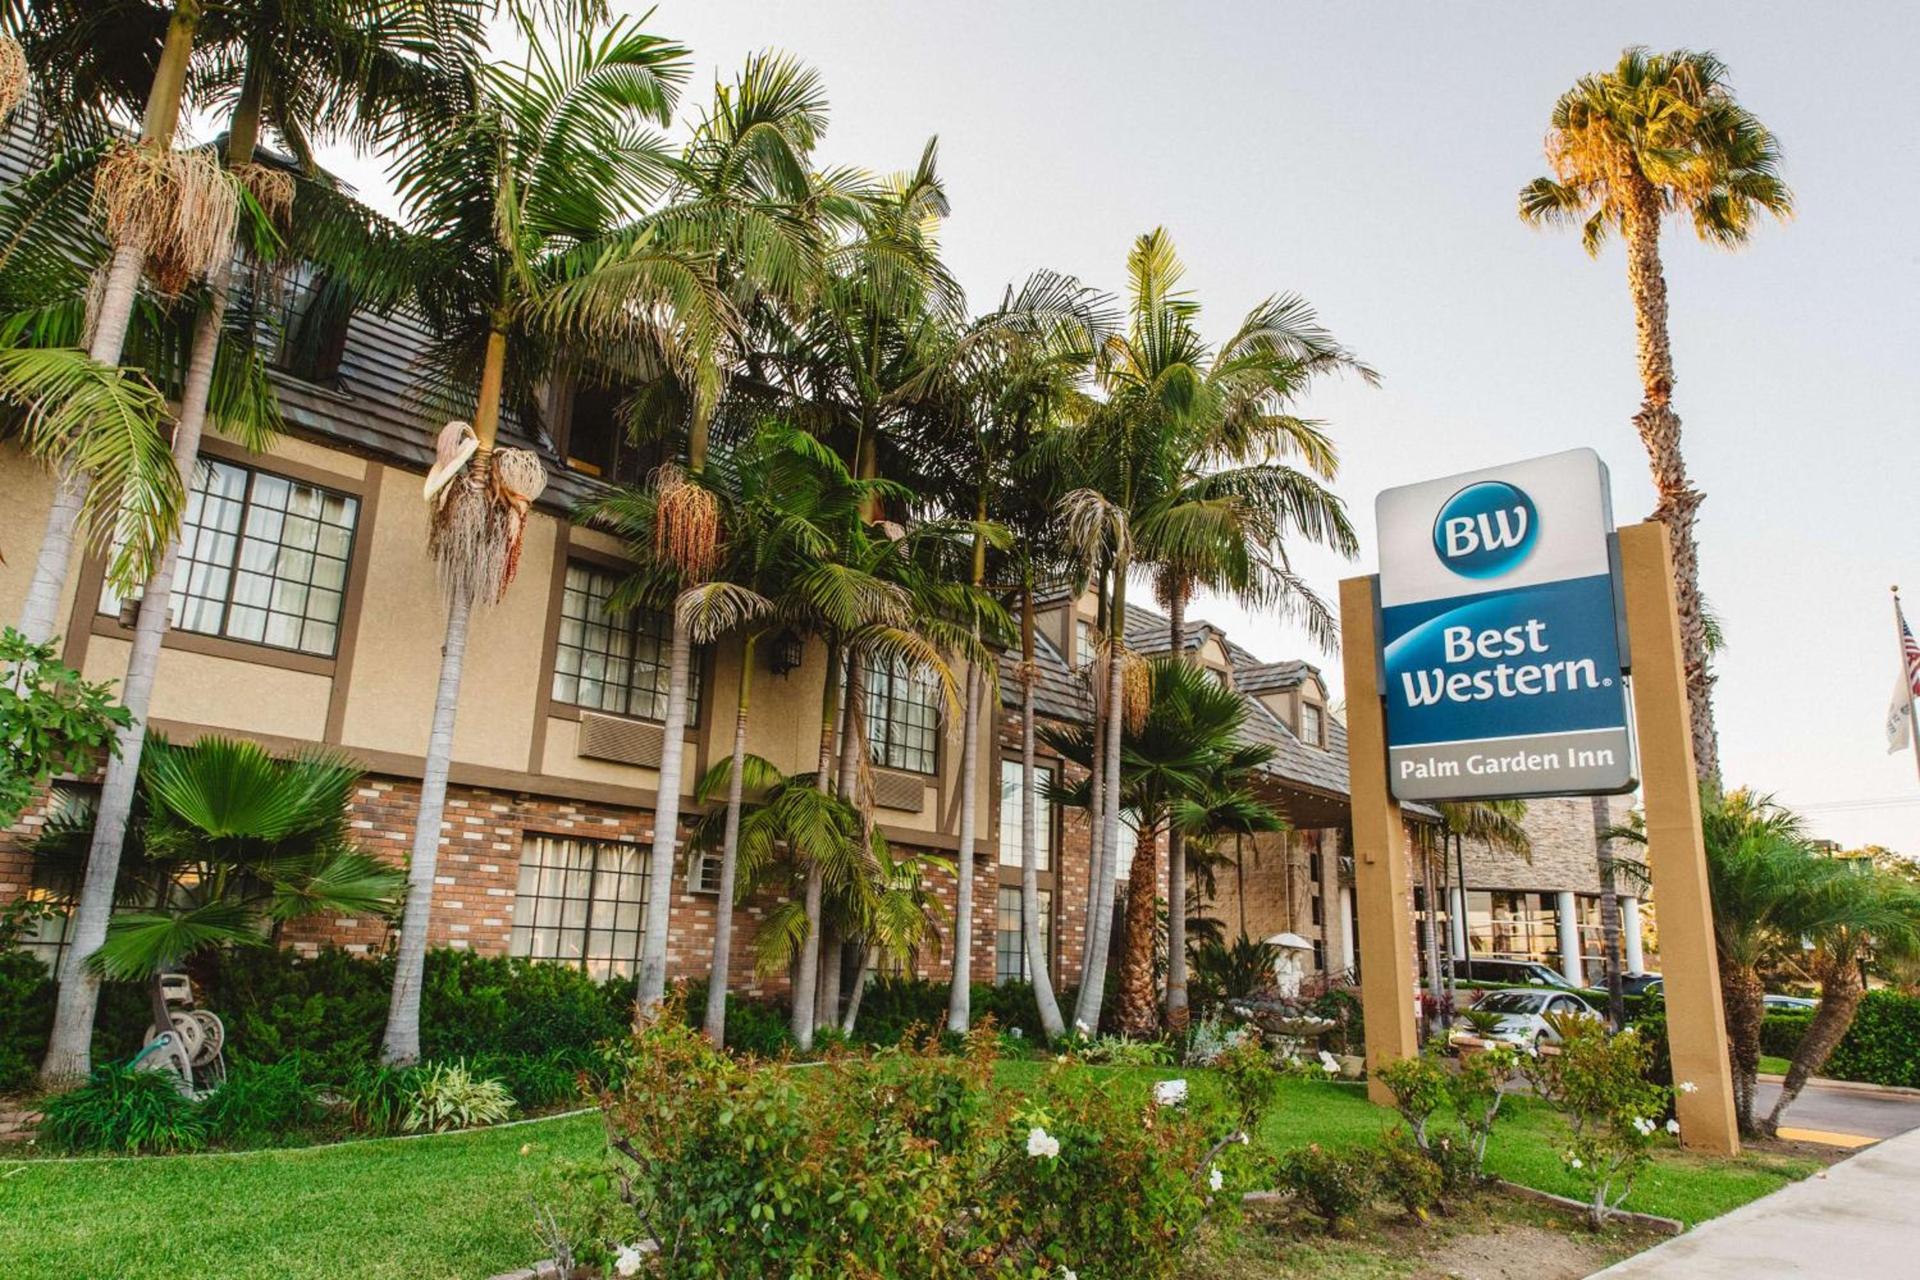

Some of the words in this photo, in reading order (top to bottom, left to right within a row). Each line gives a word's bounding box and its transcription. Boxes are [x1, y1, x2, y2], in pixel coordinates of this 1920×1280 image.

[1445, 505, 1528, 558] BW
[1444, 619, 1549, 663] Best
[1400, 757, 1460, 780] Palm
[1466, 750, 1560, 775] Garden
[1568, 747, 1615, 769] Inn
